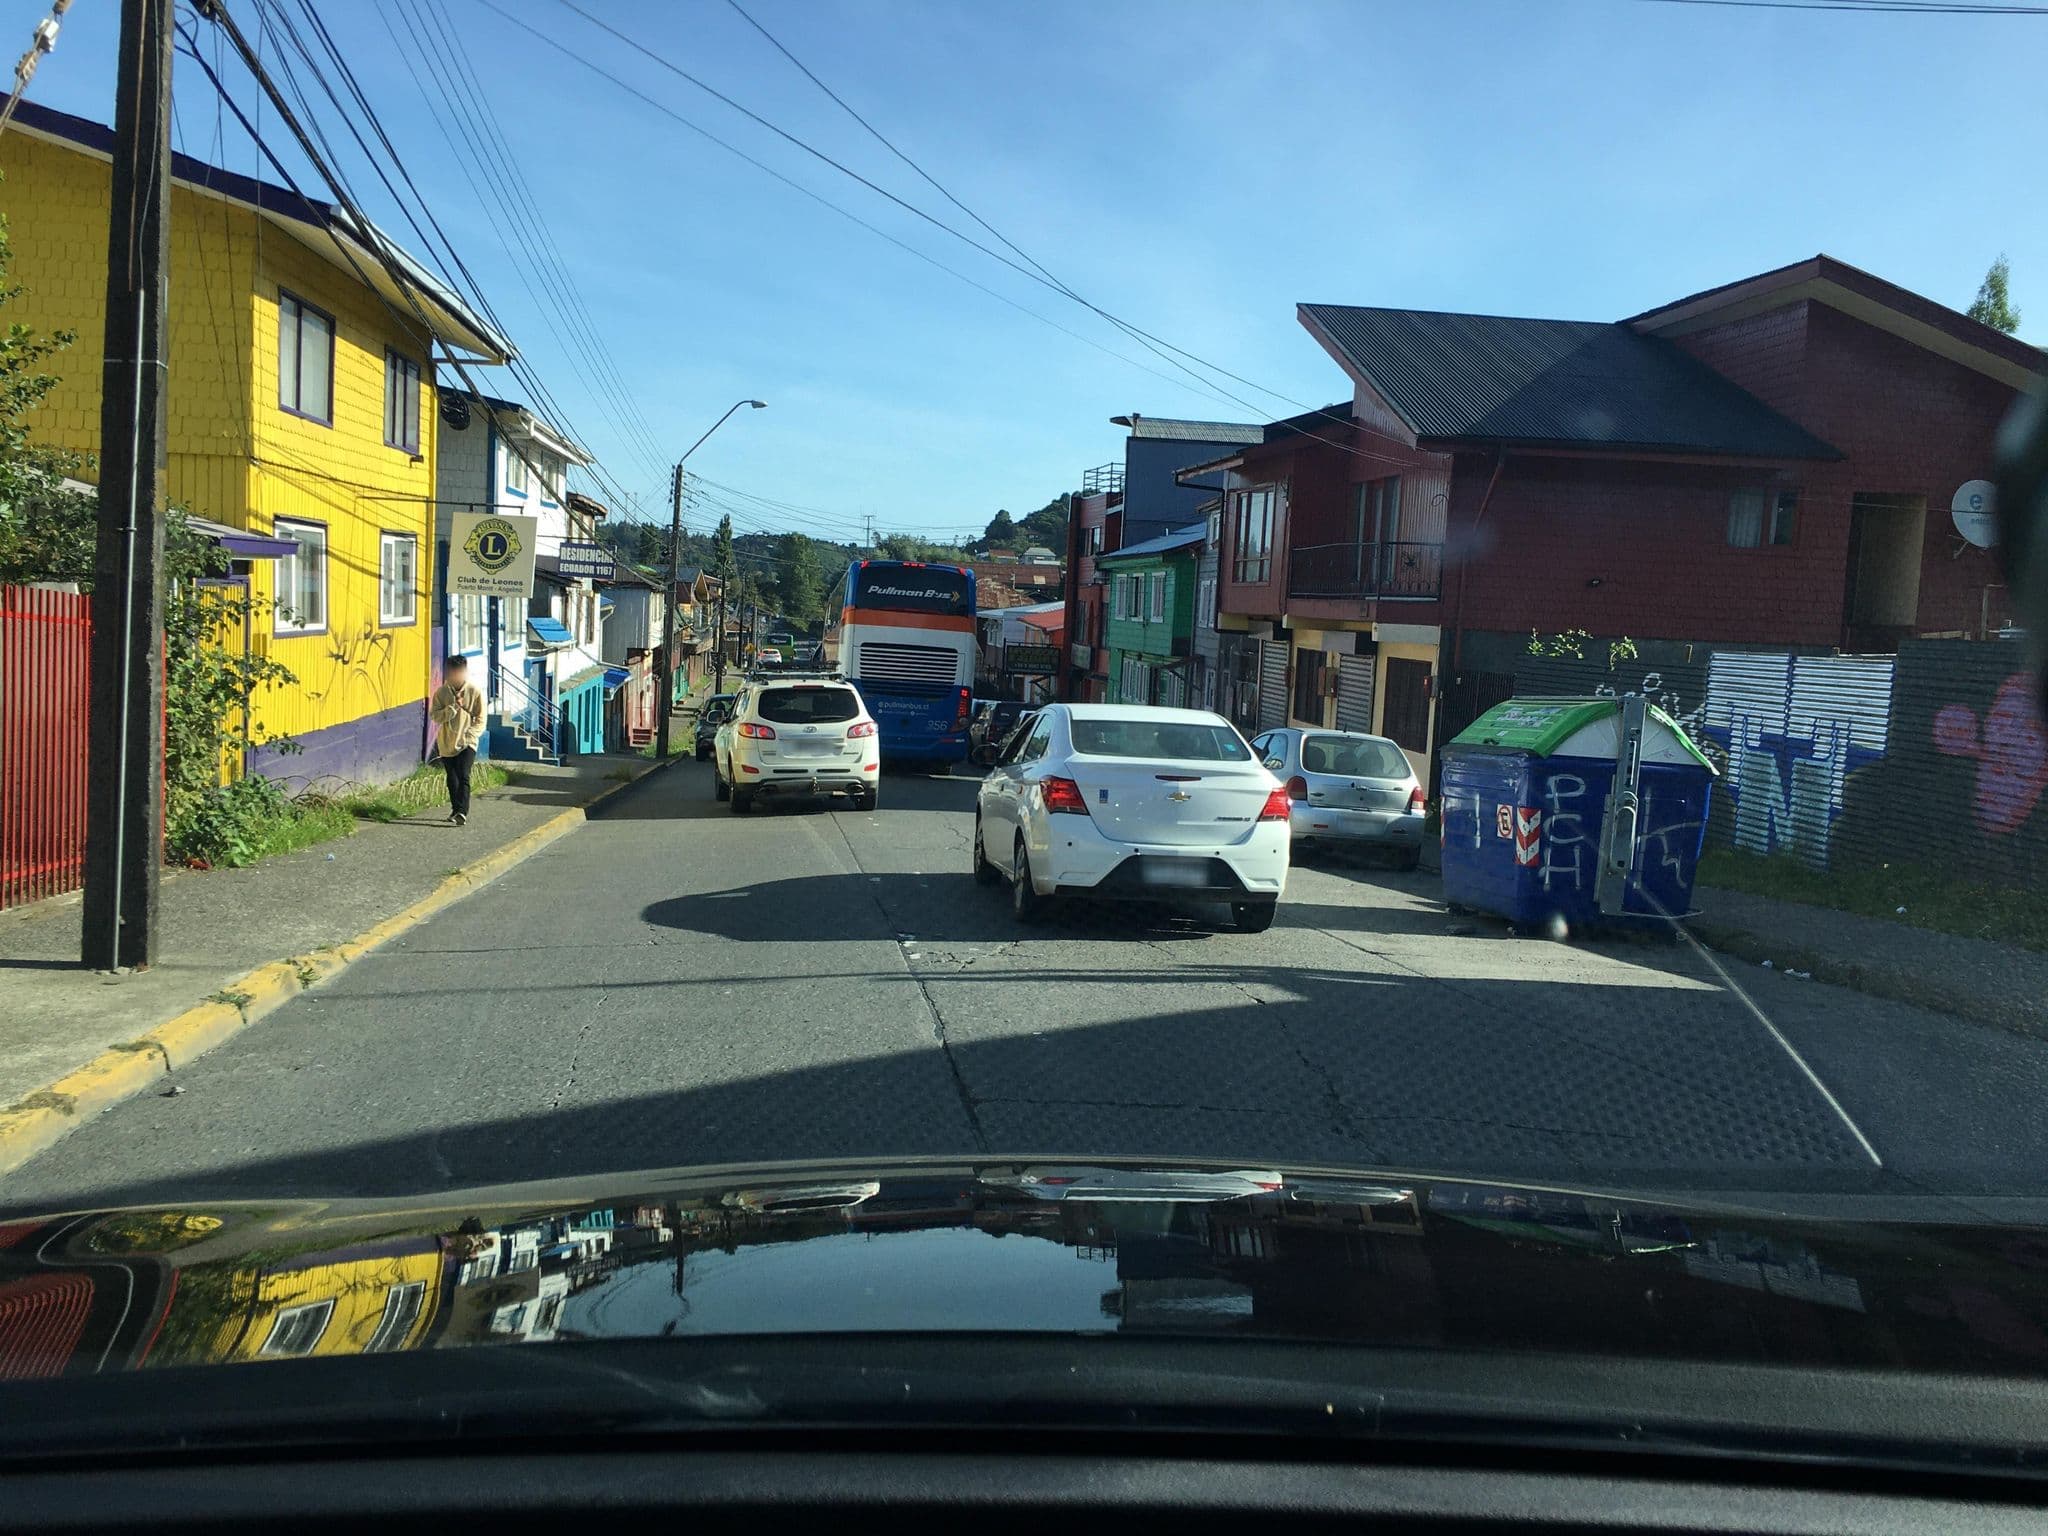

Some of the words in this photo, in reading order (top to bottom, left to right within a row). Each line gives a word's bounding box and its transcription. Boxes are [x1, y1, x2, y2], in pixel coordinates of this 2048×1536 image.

[485, 535, 501, 556] L
[559, 563, 595, 575] ECUADOR
[596, 565, 613, 576] 1167
[457, 576, 477, 584] Club
[479, 577, 490, 585] de
[492, 578, 524, 586] Leones
[457, 583, 477, 591] Puerto
[867, 585, 923, 598] Pullman
[924, 589, 951, 599] Bus
